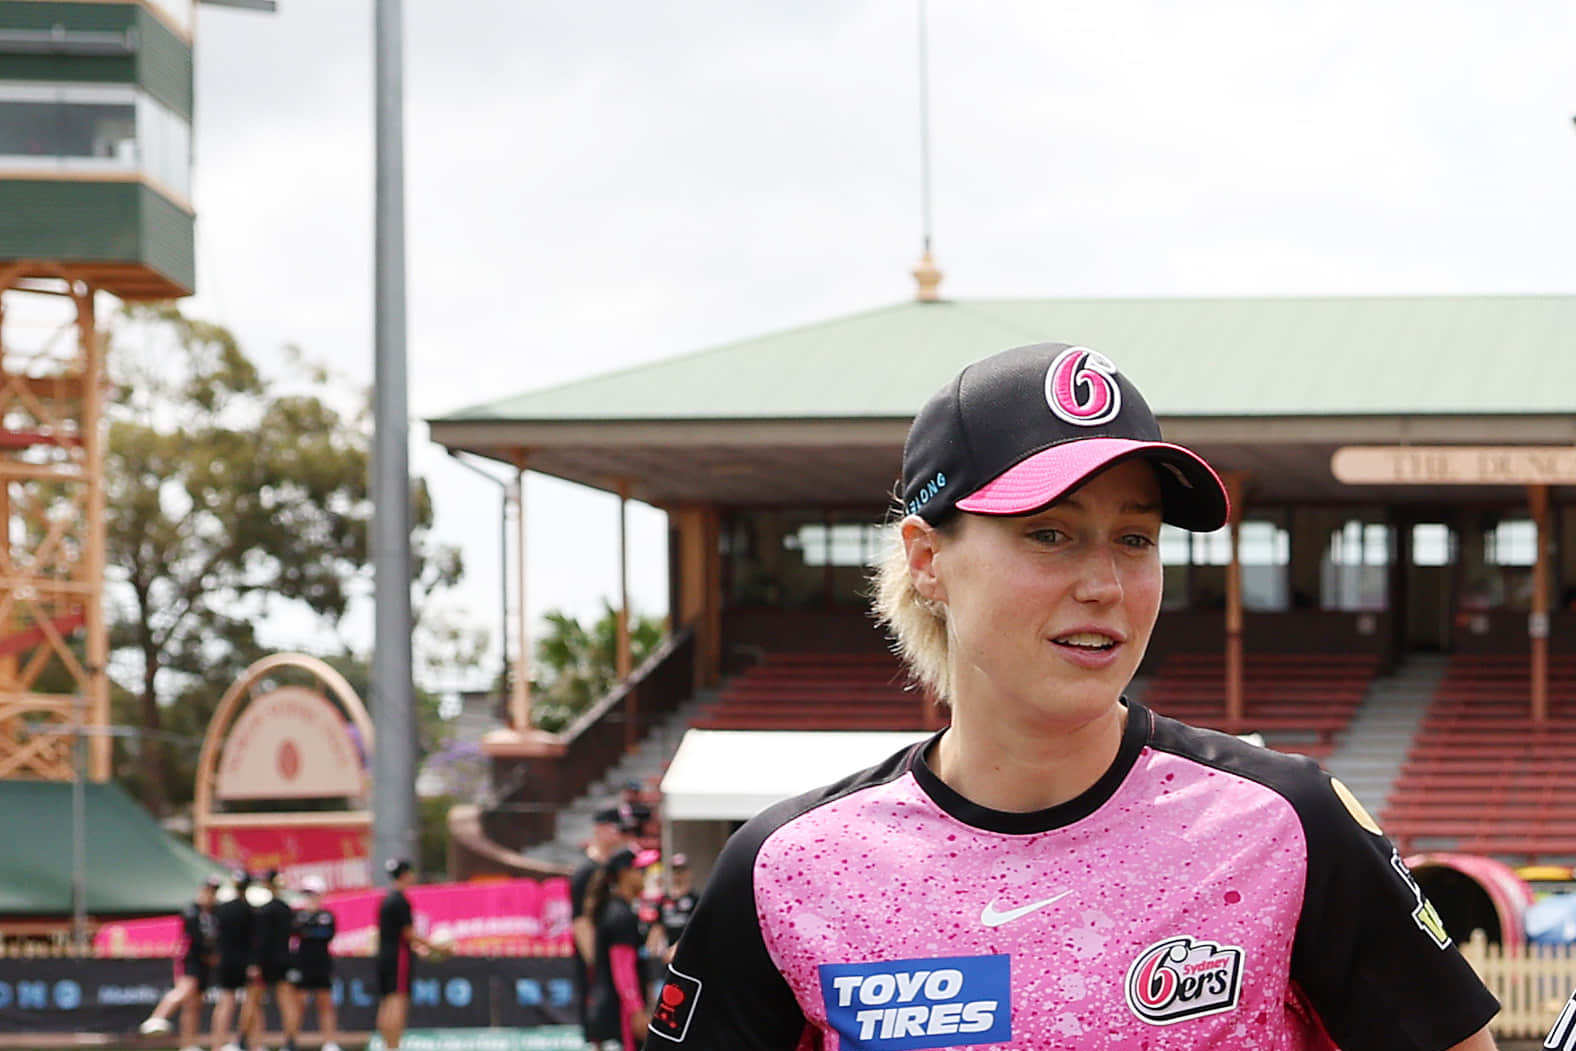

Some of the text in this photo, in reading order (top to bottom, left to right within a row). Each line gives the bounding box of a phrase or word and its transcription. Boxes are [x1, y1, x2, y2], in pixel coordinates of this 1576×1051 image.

[1045, 346, 1121, 426] 6
[905, 472, 946, 515] ELONG
[1183, 956, 1229, 976] Sydney
[833, 968, 963, 1007] TOYO
[856, 999, 999, 1041] TIRES
